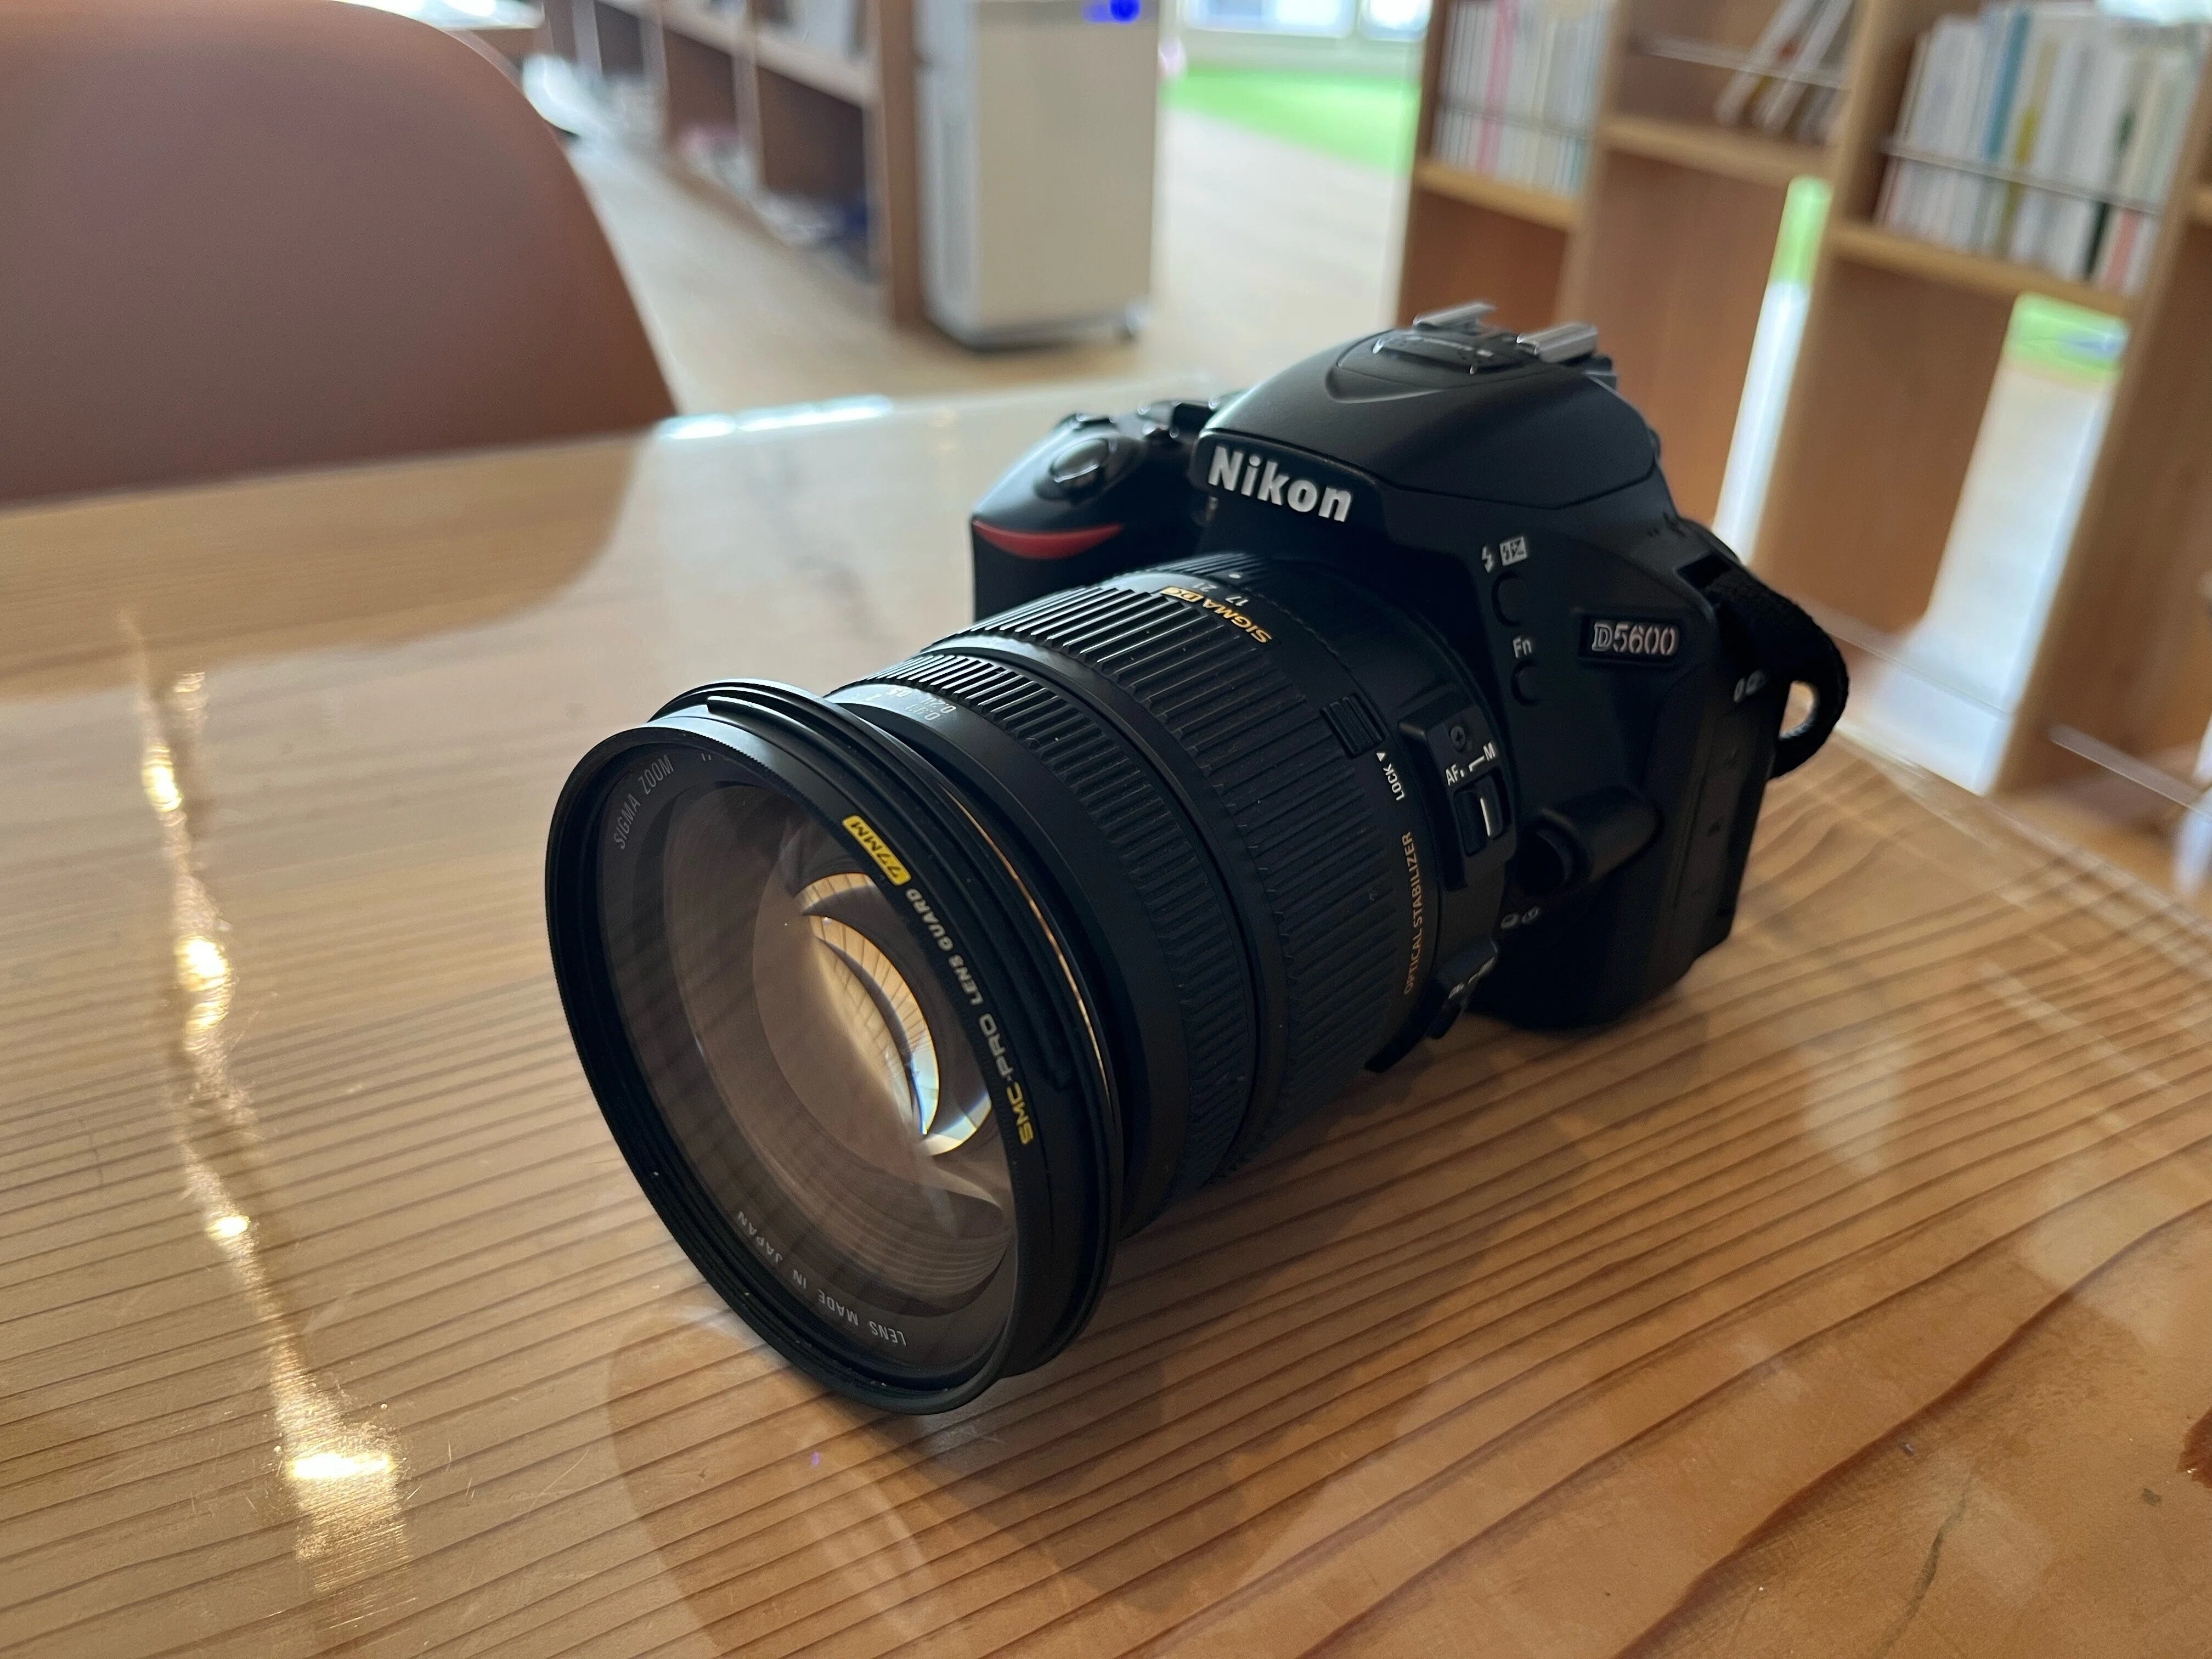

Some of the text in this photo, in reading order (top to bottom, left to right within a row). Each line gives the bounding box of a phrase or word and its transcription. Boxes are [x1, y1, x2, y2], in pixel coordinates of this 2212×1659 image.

[1208, 446, 1352, 522] Nikon
[1203, 599, 1272, 643] SIGMA
[1225, 596, 1249, 607] 17
[1513, 635, 1533, 658] Fn
[1592, 623, 1677, 654] D5600
[1383, 763, 1405, 800] LOCK
[1446, 741, 1496, 786] AF M
[613, 754, 674, 850] SIGMA ZOOM
[850, 820, 904, 879] 77MM
[906, 888, 953, 951] GUARD
[1402, 831, 1423, 995] OPTICAL STABILIZER
[948, 955, 983, 1005] LENS
[737, 1210, 907, 1346] LENS MADE IN JAPAN
